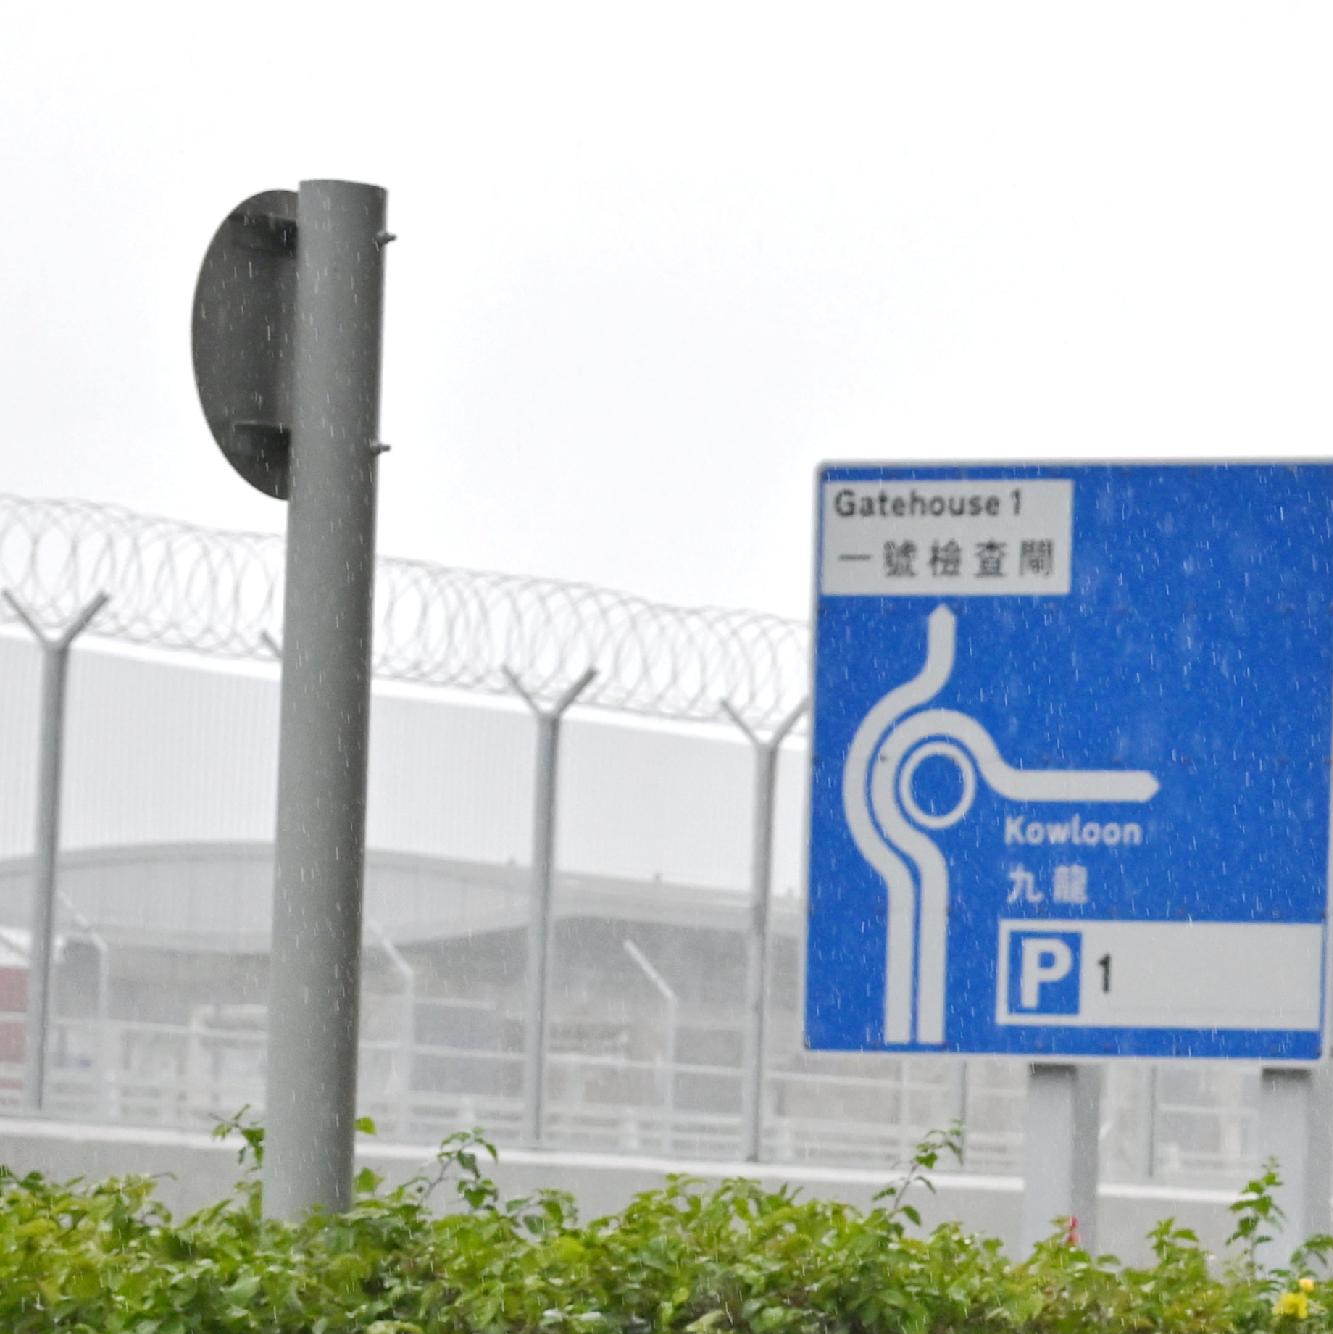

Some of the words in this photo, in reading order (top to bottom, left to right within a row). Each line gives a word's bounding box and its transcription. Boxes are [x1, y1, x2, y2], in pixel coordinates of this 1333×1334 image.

[834, 488, 1000, 517] Gatehouse
[1011, 488, 1022, 515] 1
[1004, 814, 1142, 846] Kowloon
[1020, 937, 1073, 1008] P
[1097, 953, 1112, 993] 1
